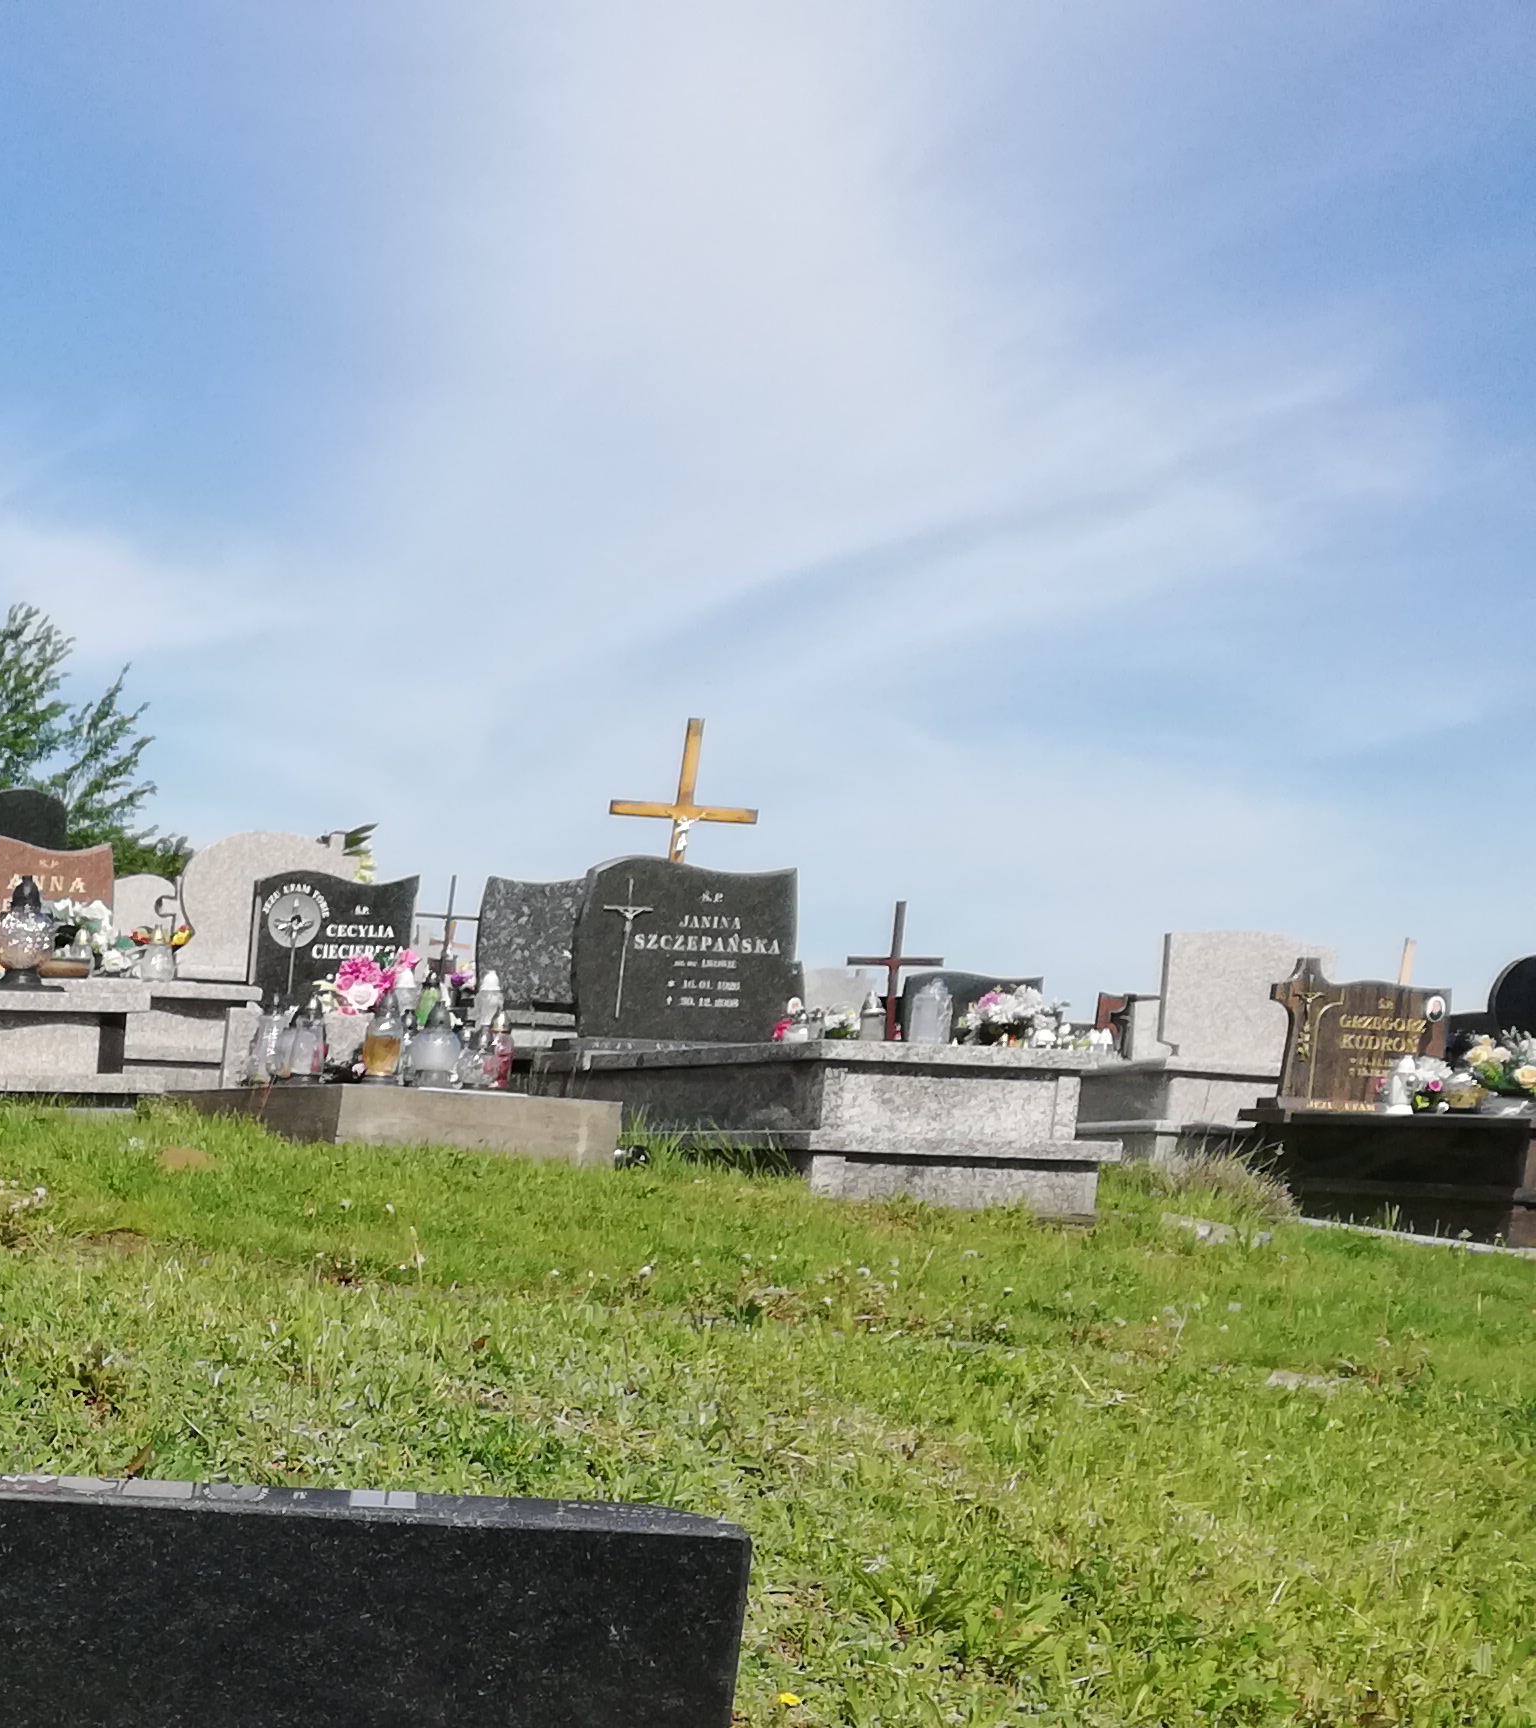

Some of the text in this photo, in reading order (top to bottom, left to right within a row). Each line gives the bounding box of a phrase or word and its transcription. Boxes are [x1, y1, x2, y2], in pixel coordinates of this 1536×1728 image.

[326, 923, 395, 938] CECYLIA
[678, 914, 741, 930] JANINA
[633, 933, 781, 955] SZCZEPAŃSKA
[1339, 1014, 1427, 1034] GRZEGORZ
[1340, 1033, 1420, 1053] KUDROŃ
